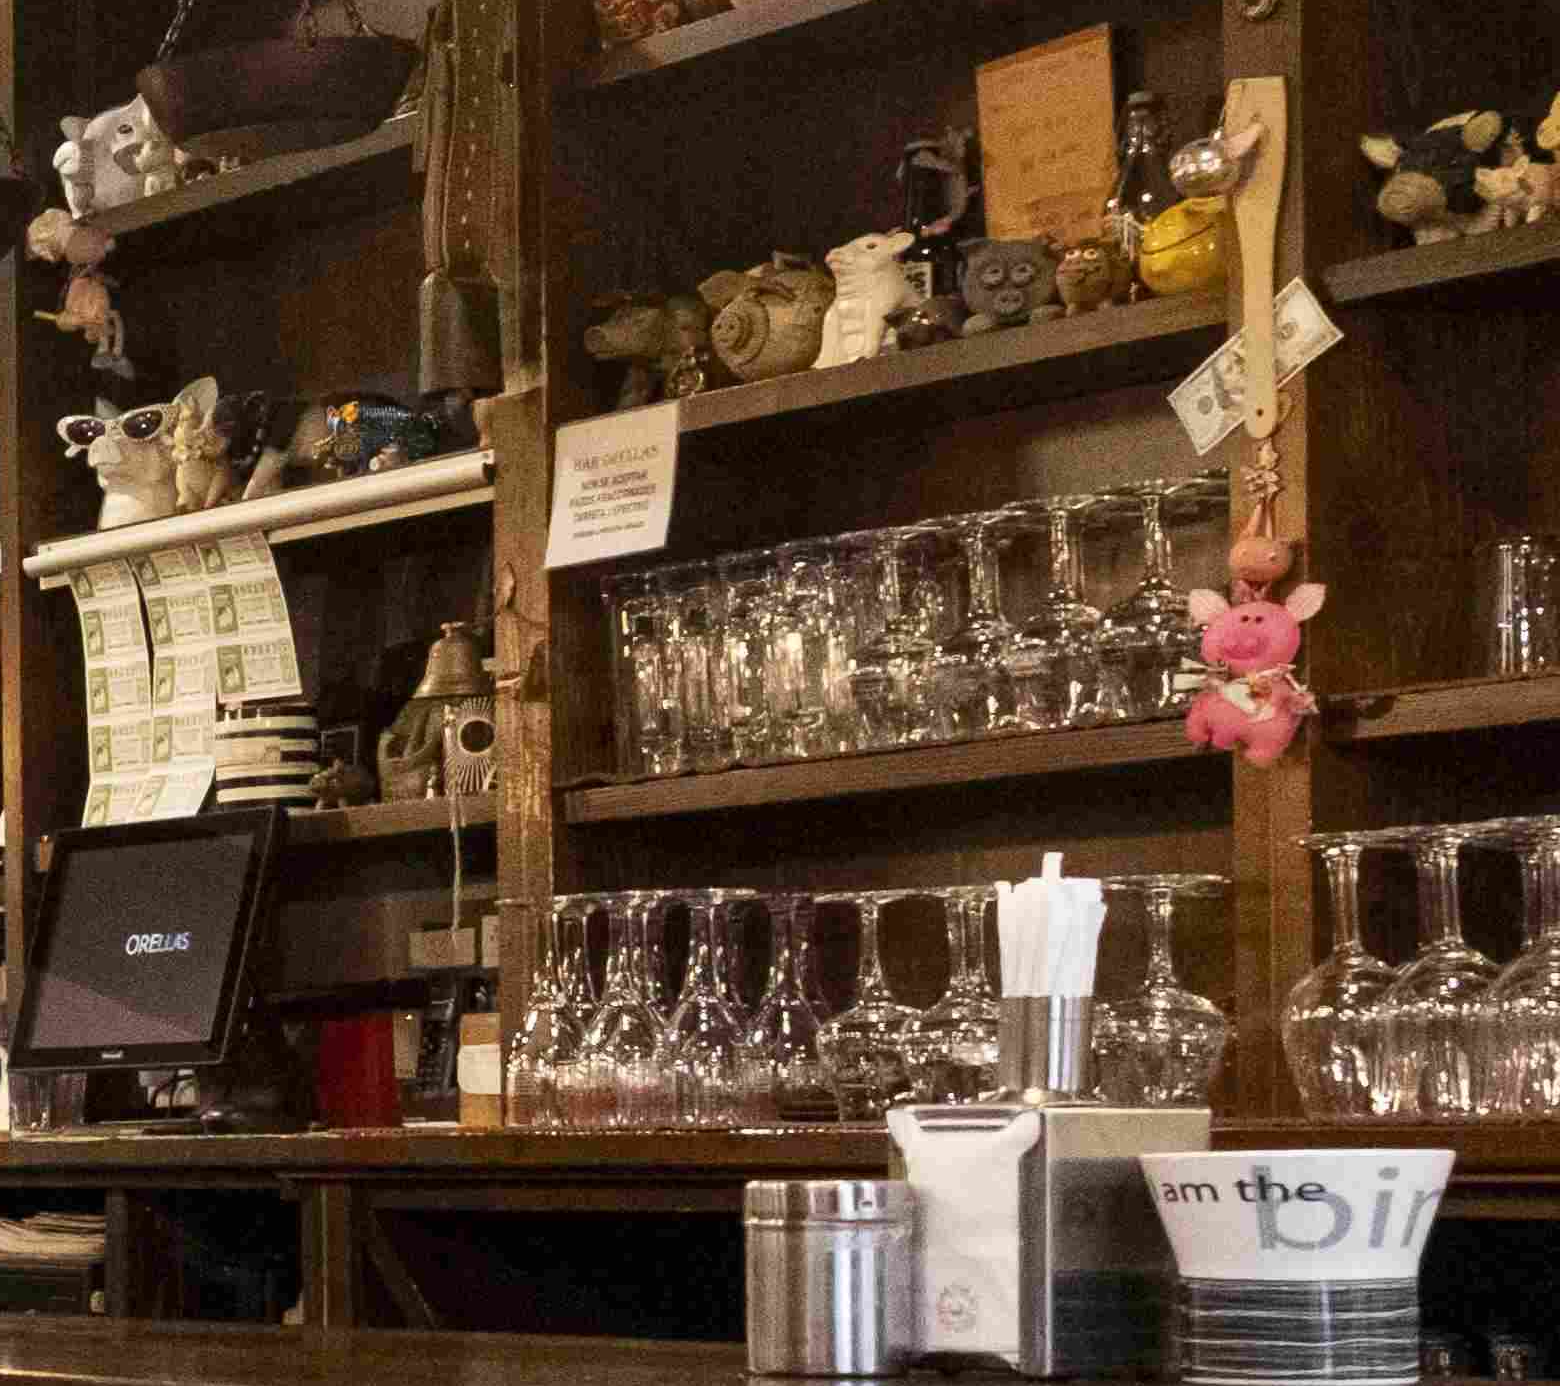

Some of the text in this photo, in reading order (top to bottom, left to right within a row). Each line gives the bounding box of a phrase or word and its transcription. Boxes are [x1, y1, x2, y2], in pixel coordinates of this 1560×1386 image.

[125, 932, 190, 956] ORELLAS
[1161, 1181, 1219, 1203] am
[1234, 1173, 1328, 1203] the
